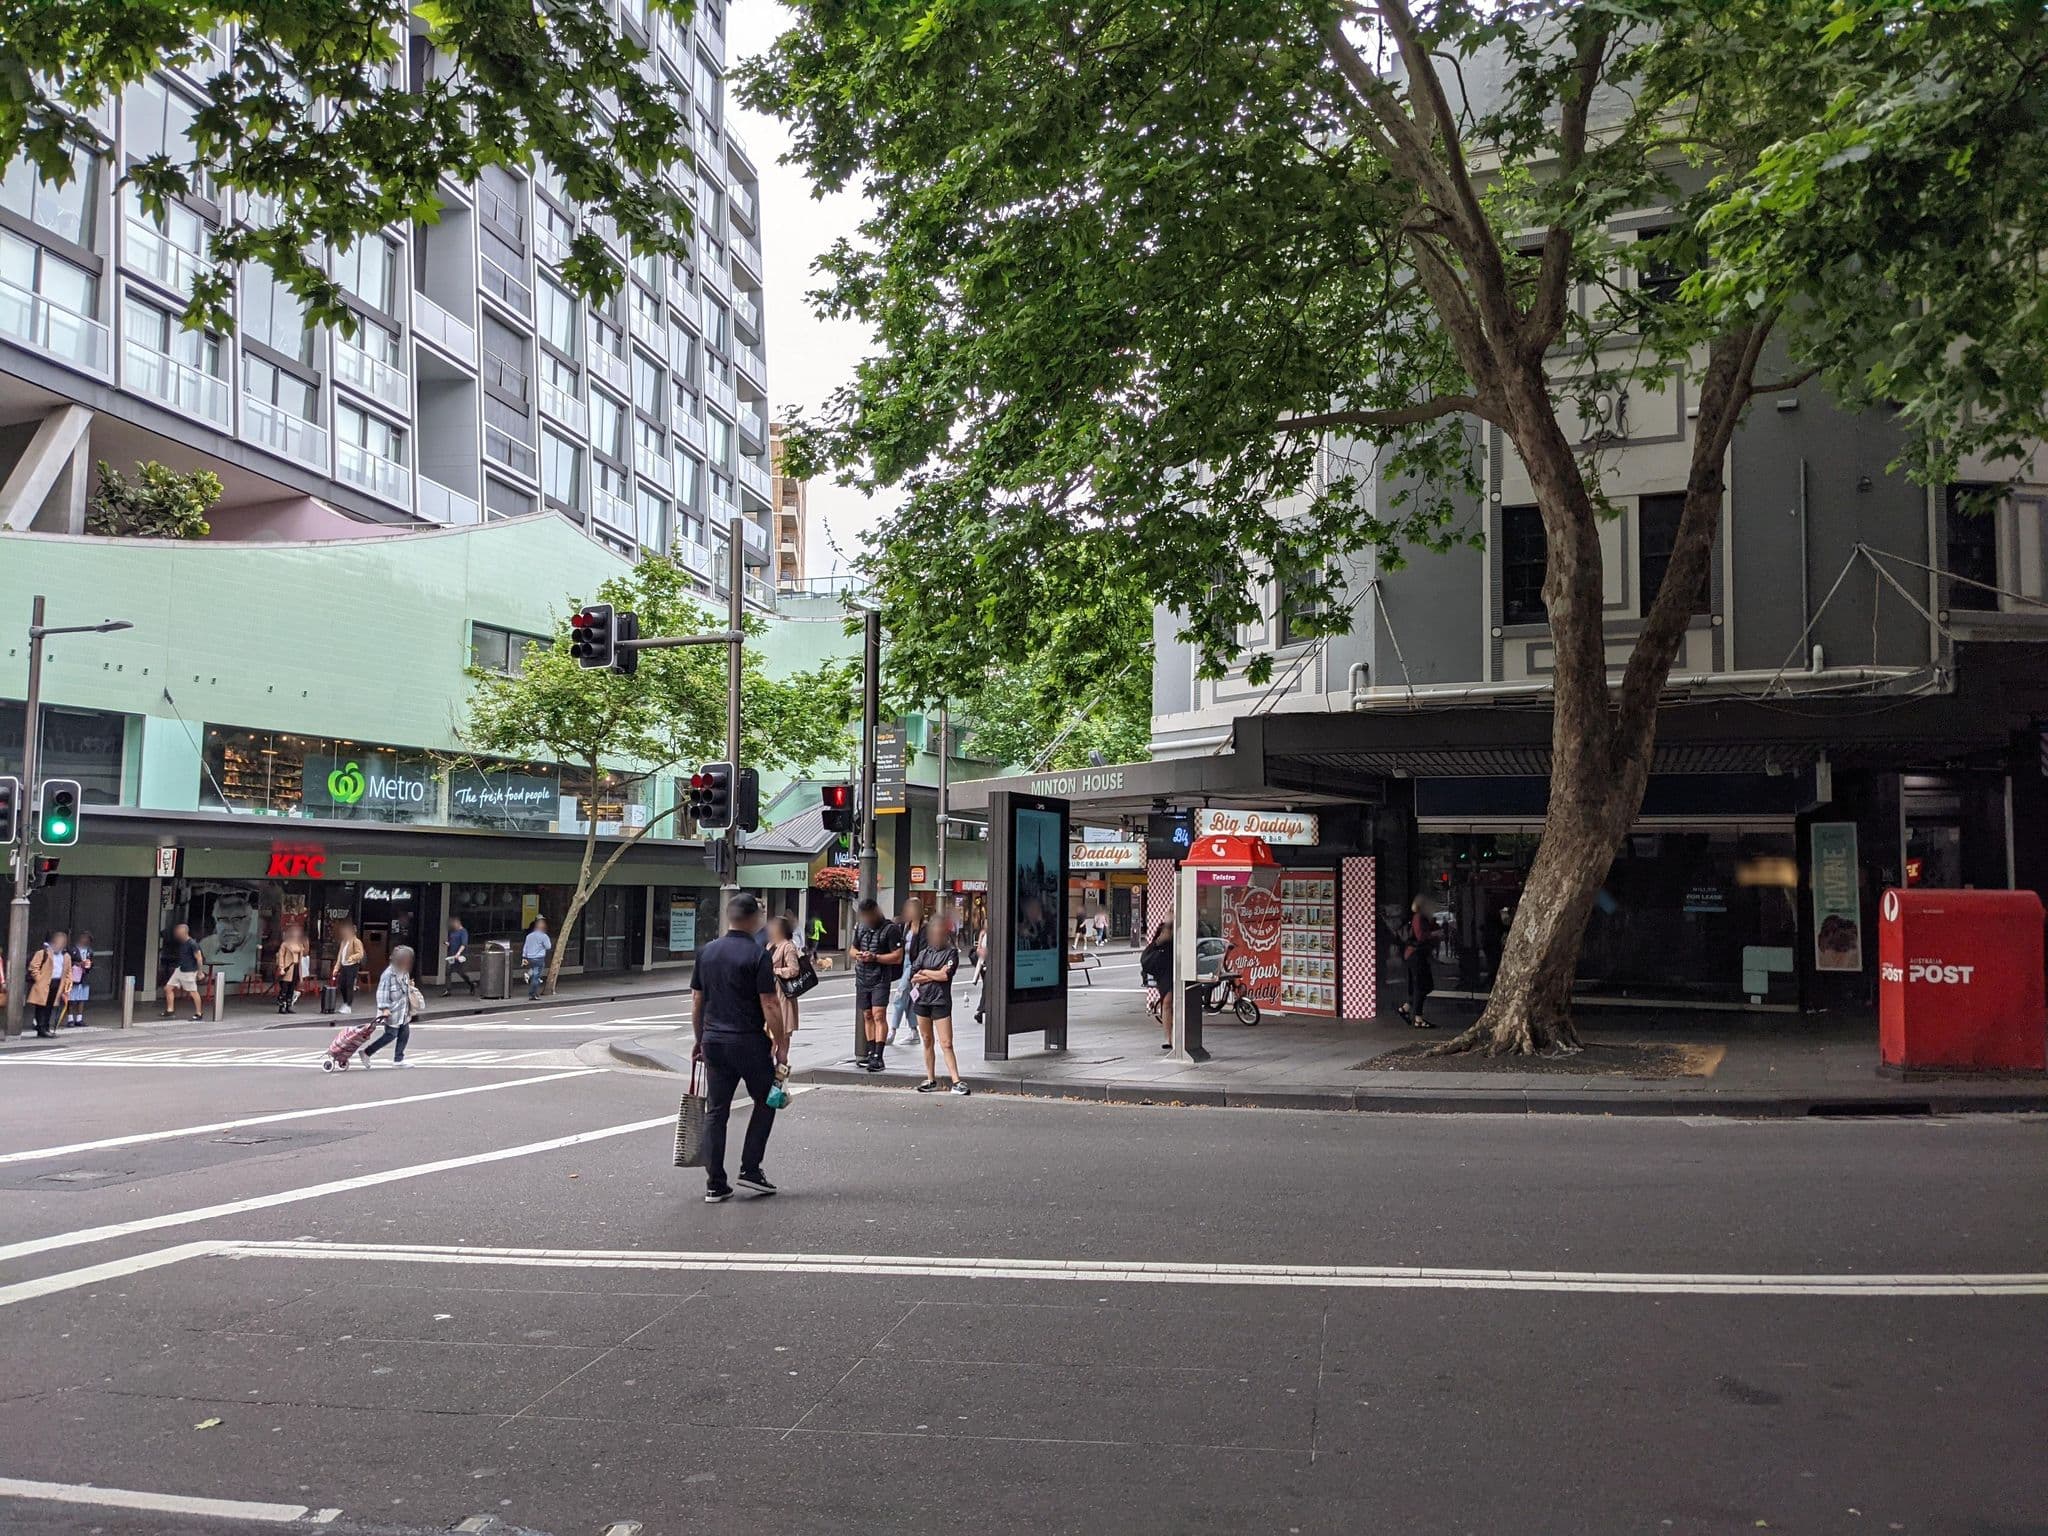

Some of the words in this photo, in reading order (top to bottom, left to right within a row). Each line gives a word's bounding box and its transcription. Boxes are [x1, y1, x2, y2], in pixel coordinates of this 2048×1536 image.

[369, 775, 424, 802] Metro
[1031, 777, 1076, 796] MINTON
[1082, 772, 1124, 792] HOUSE
[455, 788, 477, 804] The
[479, 788, 504, 808] fresh
[504, 786, 524, 807] food
[524, 786, 550, 805] people
[1209, 811, 1240, 836] Big
[1244, 814, 1304, 837] Daddy's
[1071, 844, 1133, 865] Daddy's
[267, 854, 326, 878] KFC
[961, 881, 986, 891] HUNGRY
[1212, 873, 1236, 881] Telstra
[1235, 955, 1260, 969] Who's
[1249, 964, 1280, 986] your
[1882, 967, 1904, 982] POST
[1909, 965, 1975, 984] POST
[1245, 984, 1281, 1003] addy
